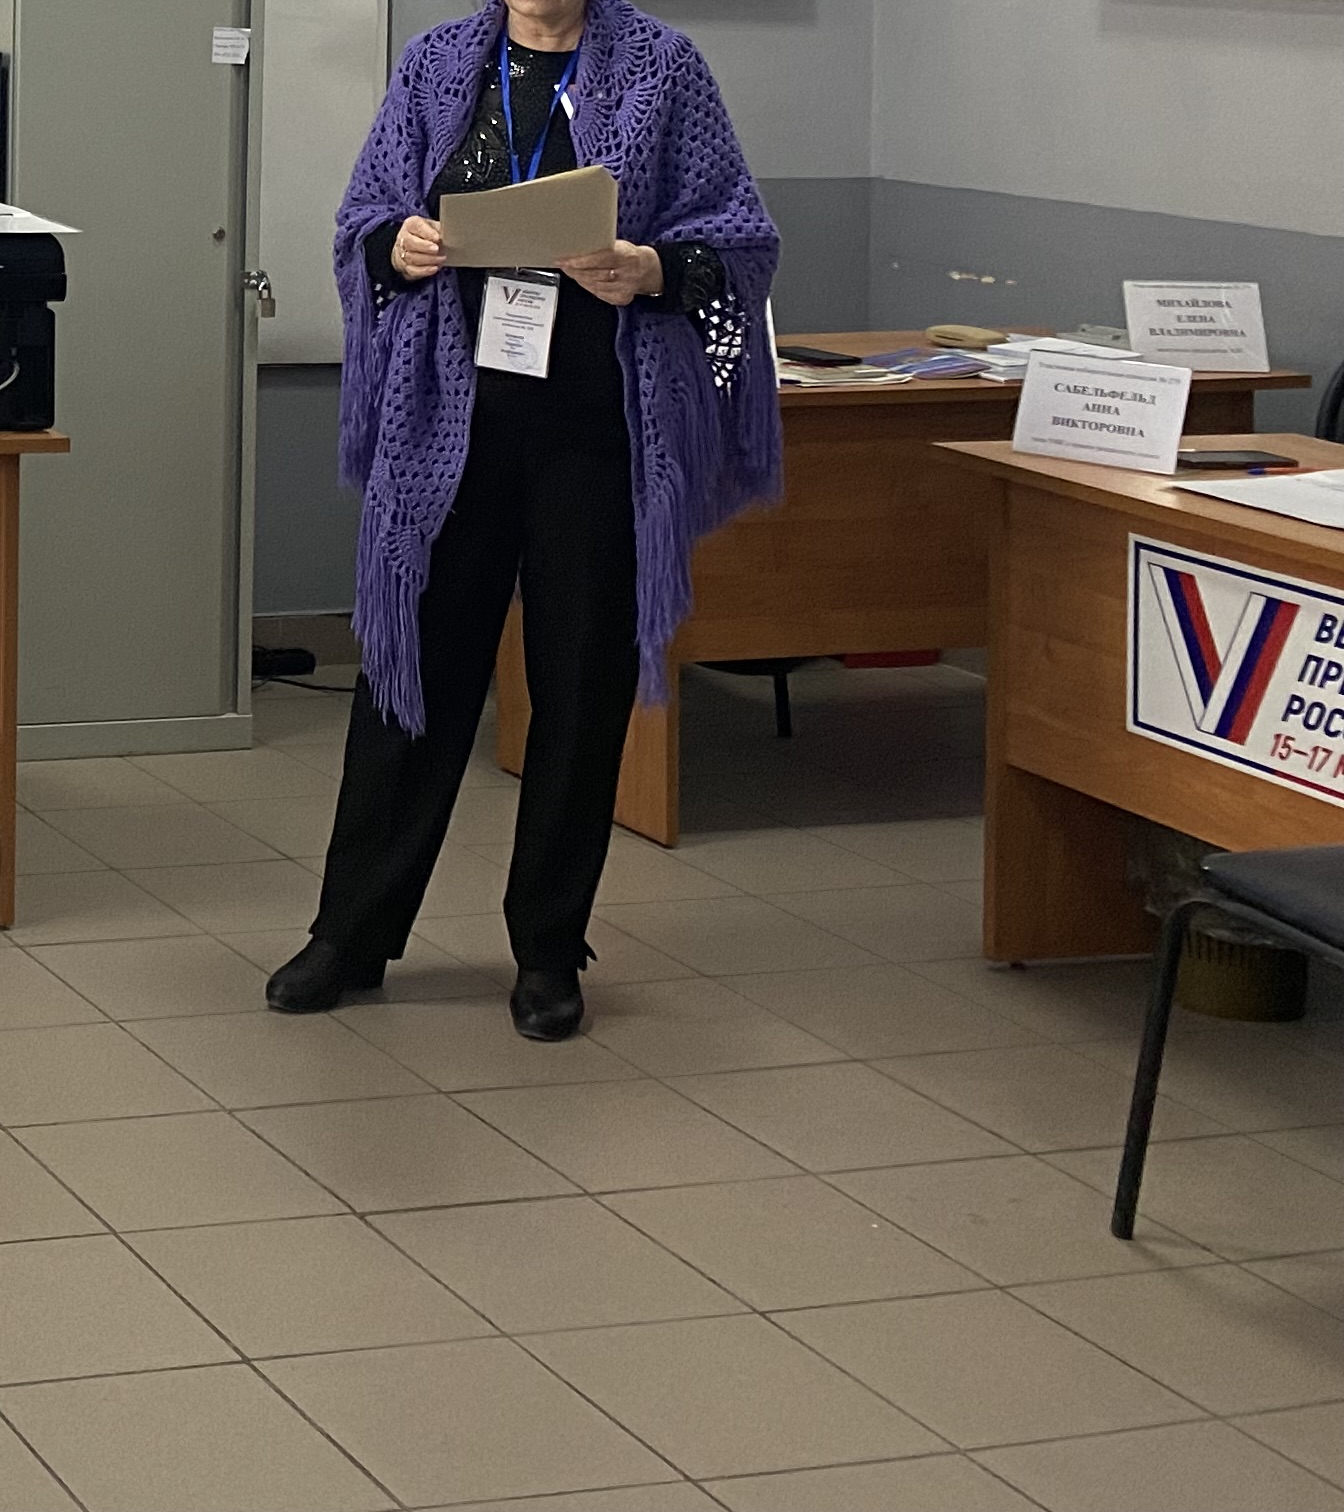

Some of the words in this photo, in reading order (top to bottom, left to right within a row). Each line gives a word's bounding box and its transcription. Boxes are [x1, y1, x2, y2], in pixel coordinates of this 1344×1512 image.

[1053, 382, 1157, 406] САБЕЛЬФЕЛЬД
[1082, 402, 1121, 416] АННА
[1051, 415, 1145, 438] ВИКТОРОВНА
